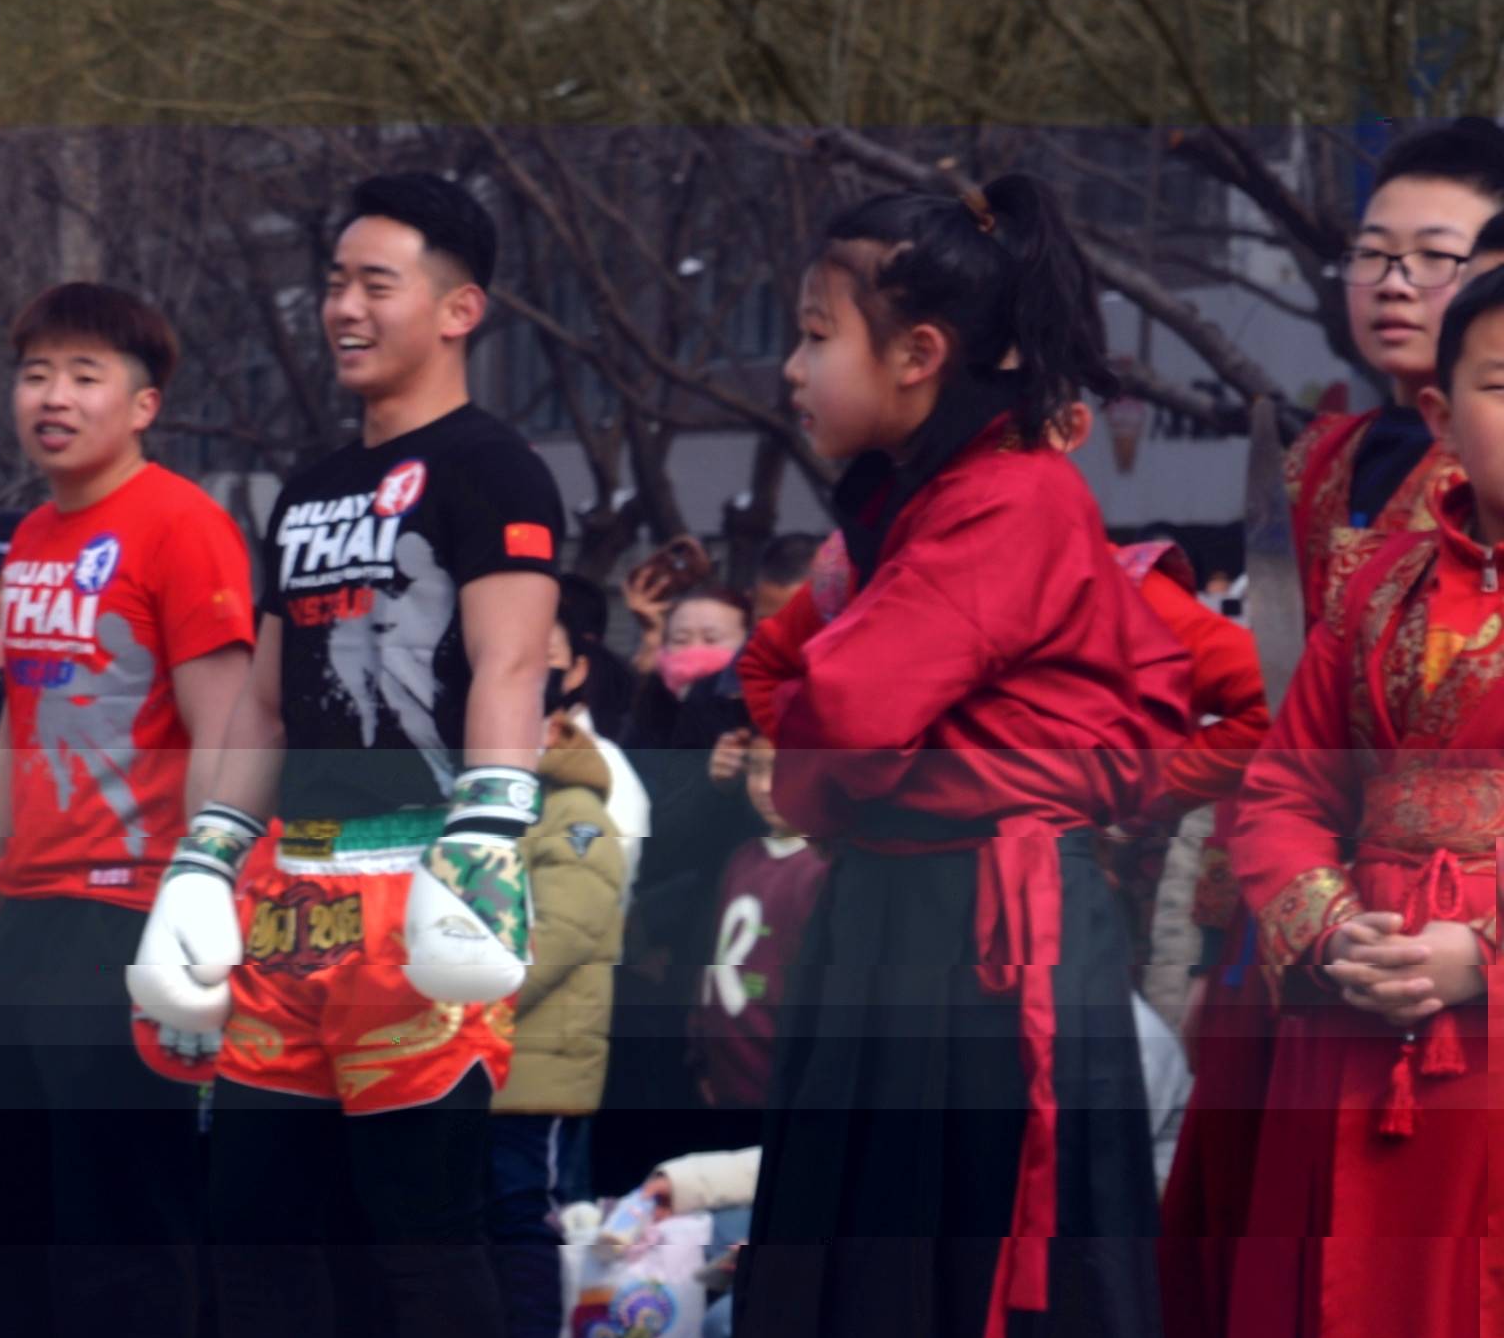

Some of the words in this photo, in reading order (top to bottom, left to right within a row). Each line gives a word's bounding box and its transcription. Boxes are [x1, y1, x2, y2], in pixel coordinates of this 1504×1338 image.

[284, 491, 377, 527] MUAY
[276, 515, 401, 592] THAI
[3, 587, 100, 639] THAI
